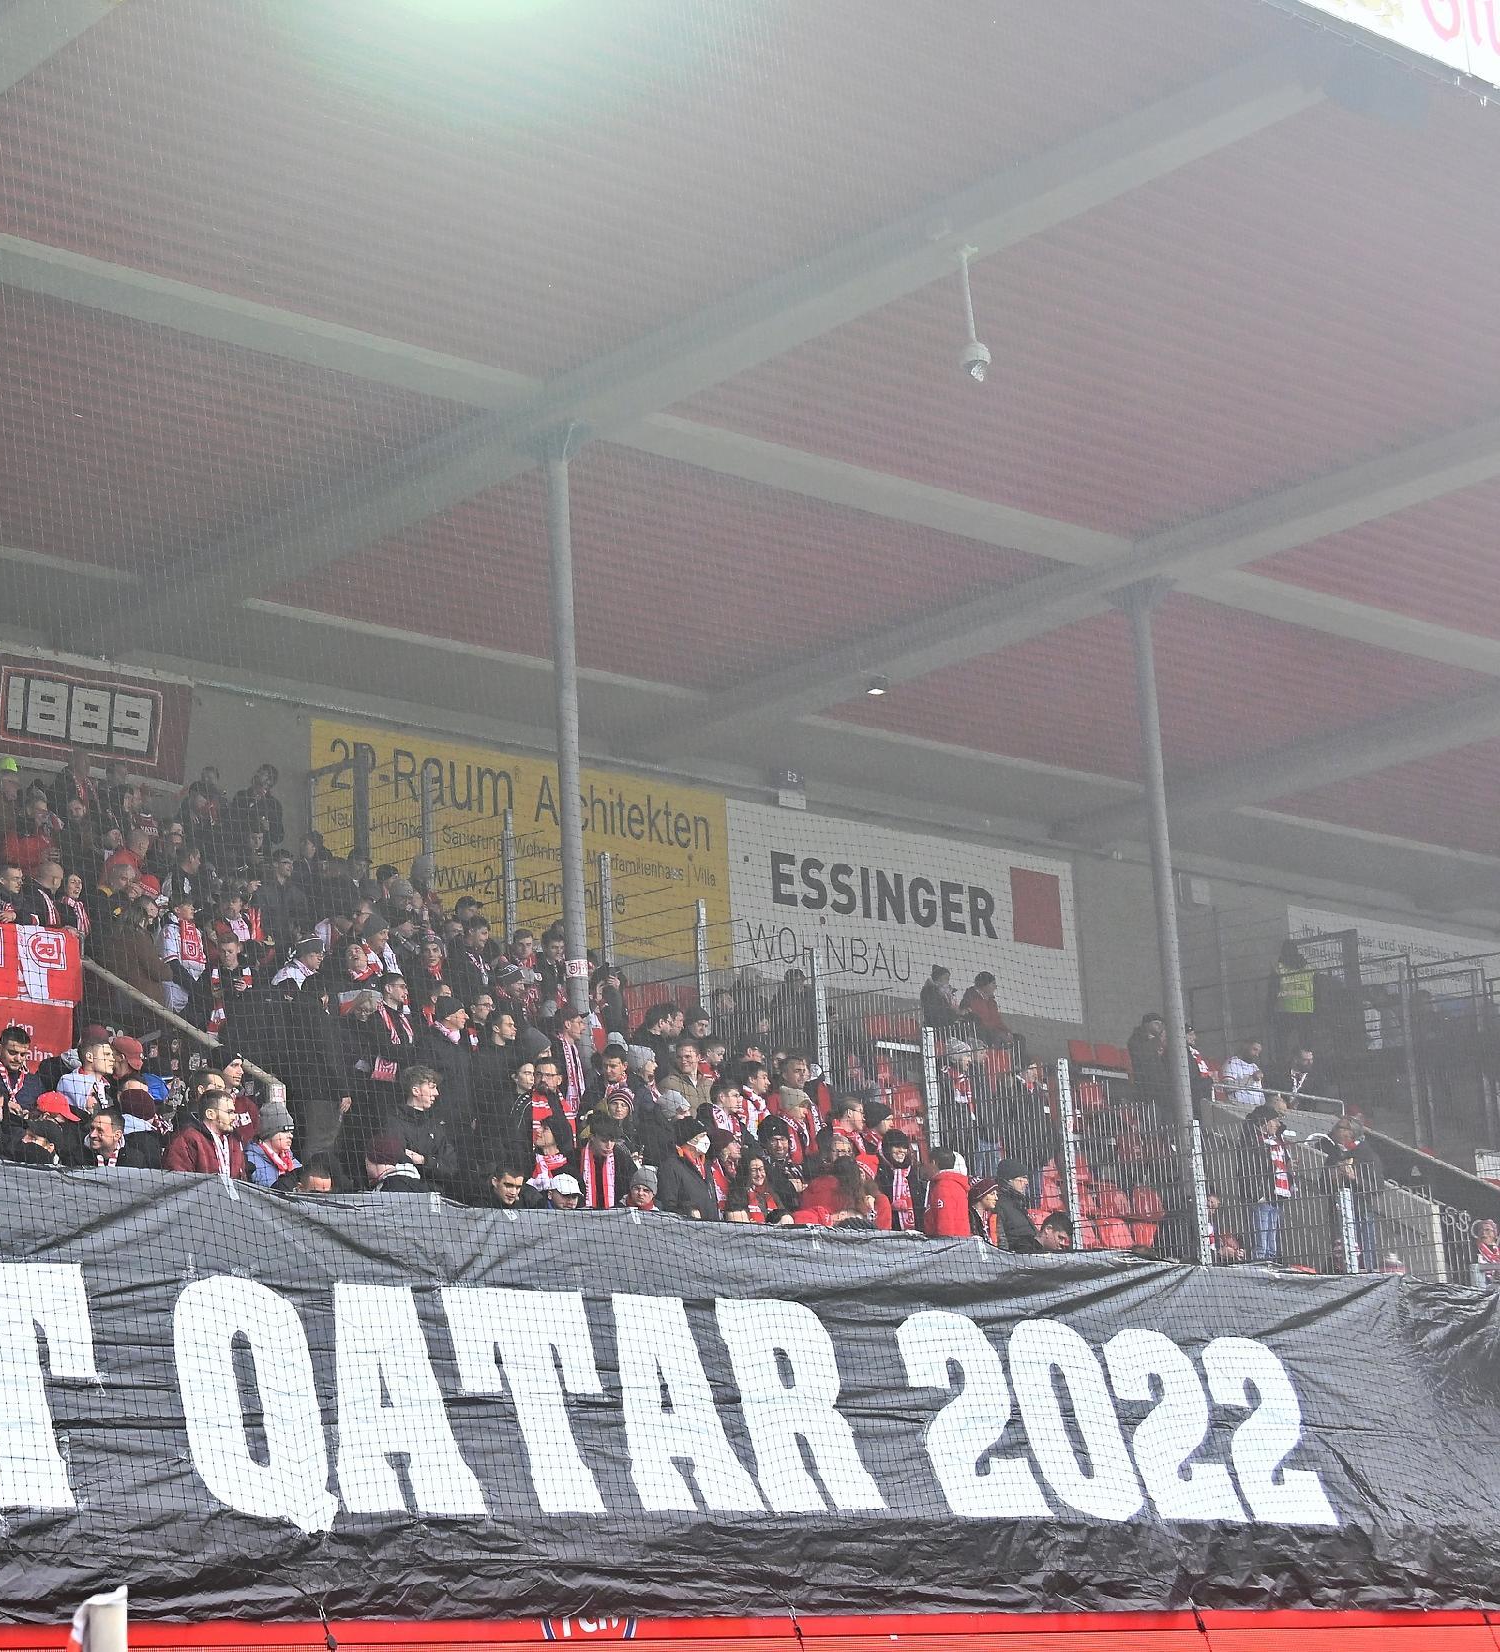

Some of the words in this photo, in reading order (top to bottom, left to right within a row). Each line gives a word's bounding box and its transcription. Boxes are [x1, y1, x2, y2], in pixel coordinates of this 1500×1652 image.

[7, 675, 154, 754] 1889
[770, 850, 999, 940] ESSINGER
[746, 920, 912, 983] WOHNBAU
[173, 1275, 888, 1533] QATAR
[896, 1310, 1341, 1526] 2022
